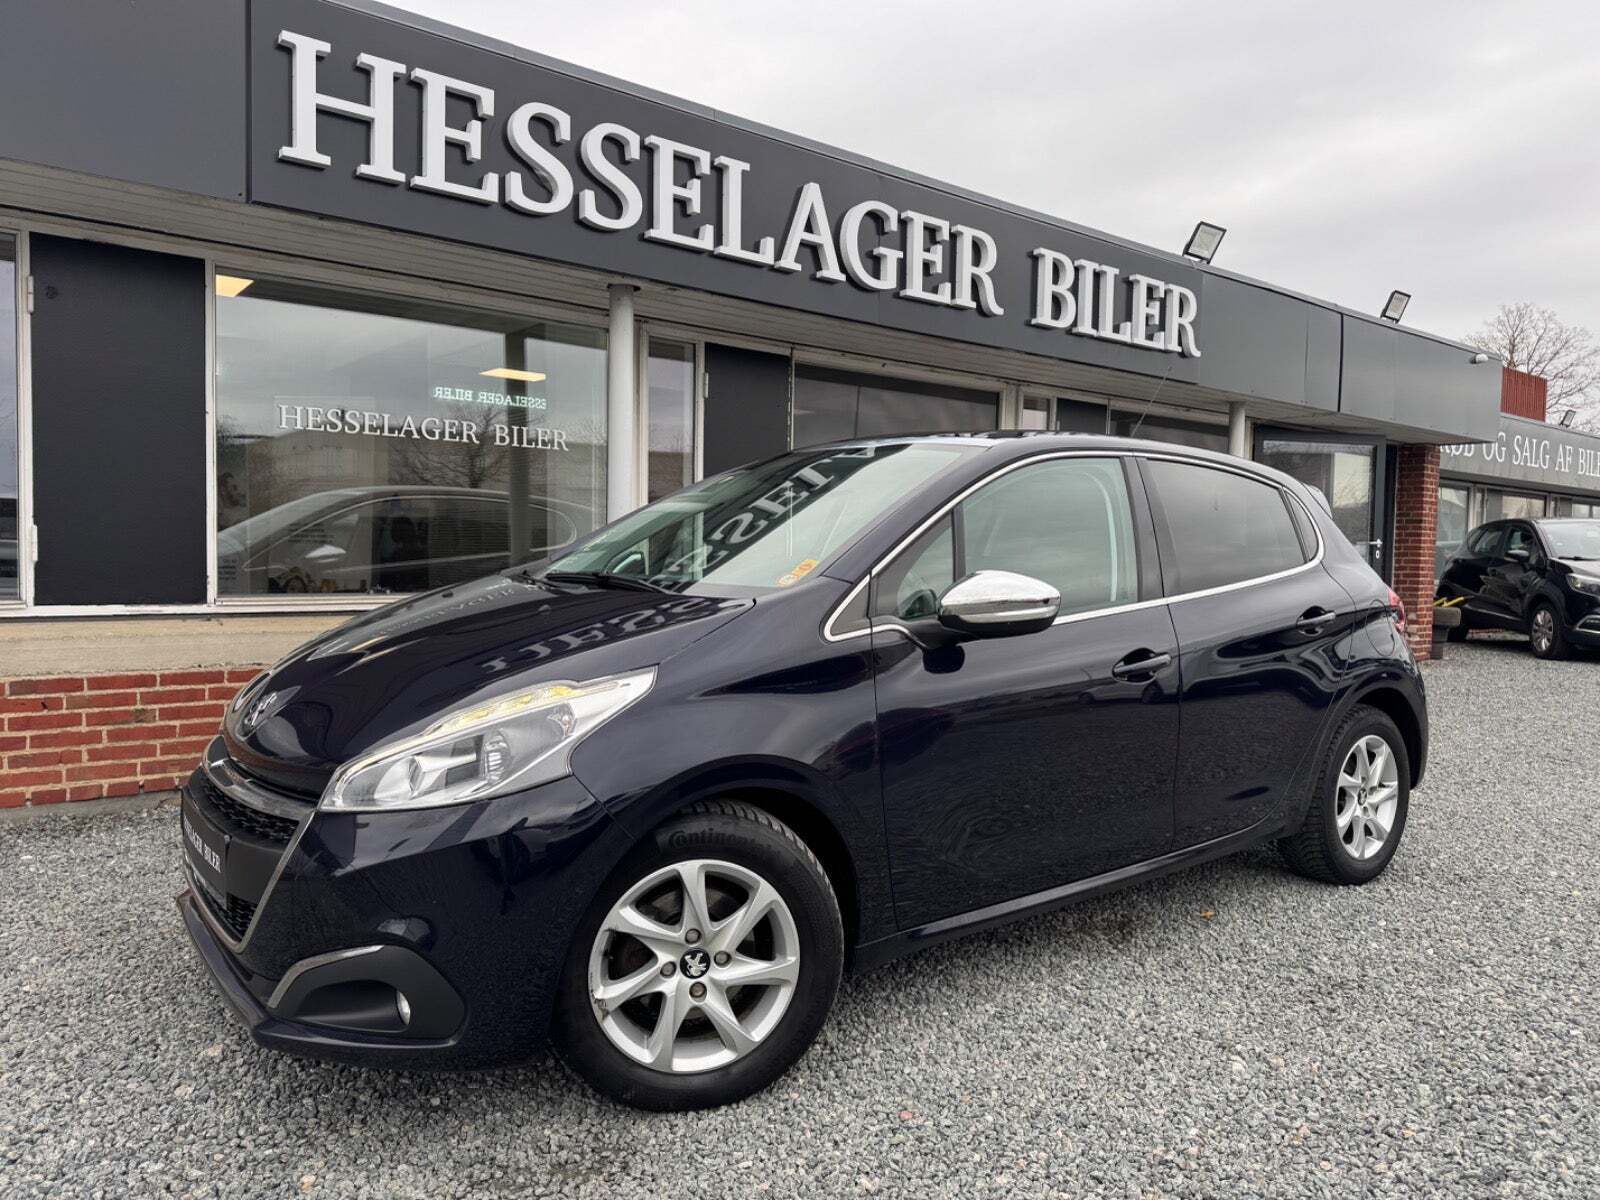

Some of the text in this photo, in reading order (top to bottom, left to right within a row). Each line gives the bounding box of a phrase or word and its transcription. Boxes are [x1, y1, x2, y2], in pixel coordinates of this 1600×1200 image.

[278, 29, 1201, 357] HESSELAGER BILER
[278, 404, 569, 451] HESSELAGER BILER
[1512, 435, 1550, 469] SALG
[1555, 443, 1573, 472] AF
